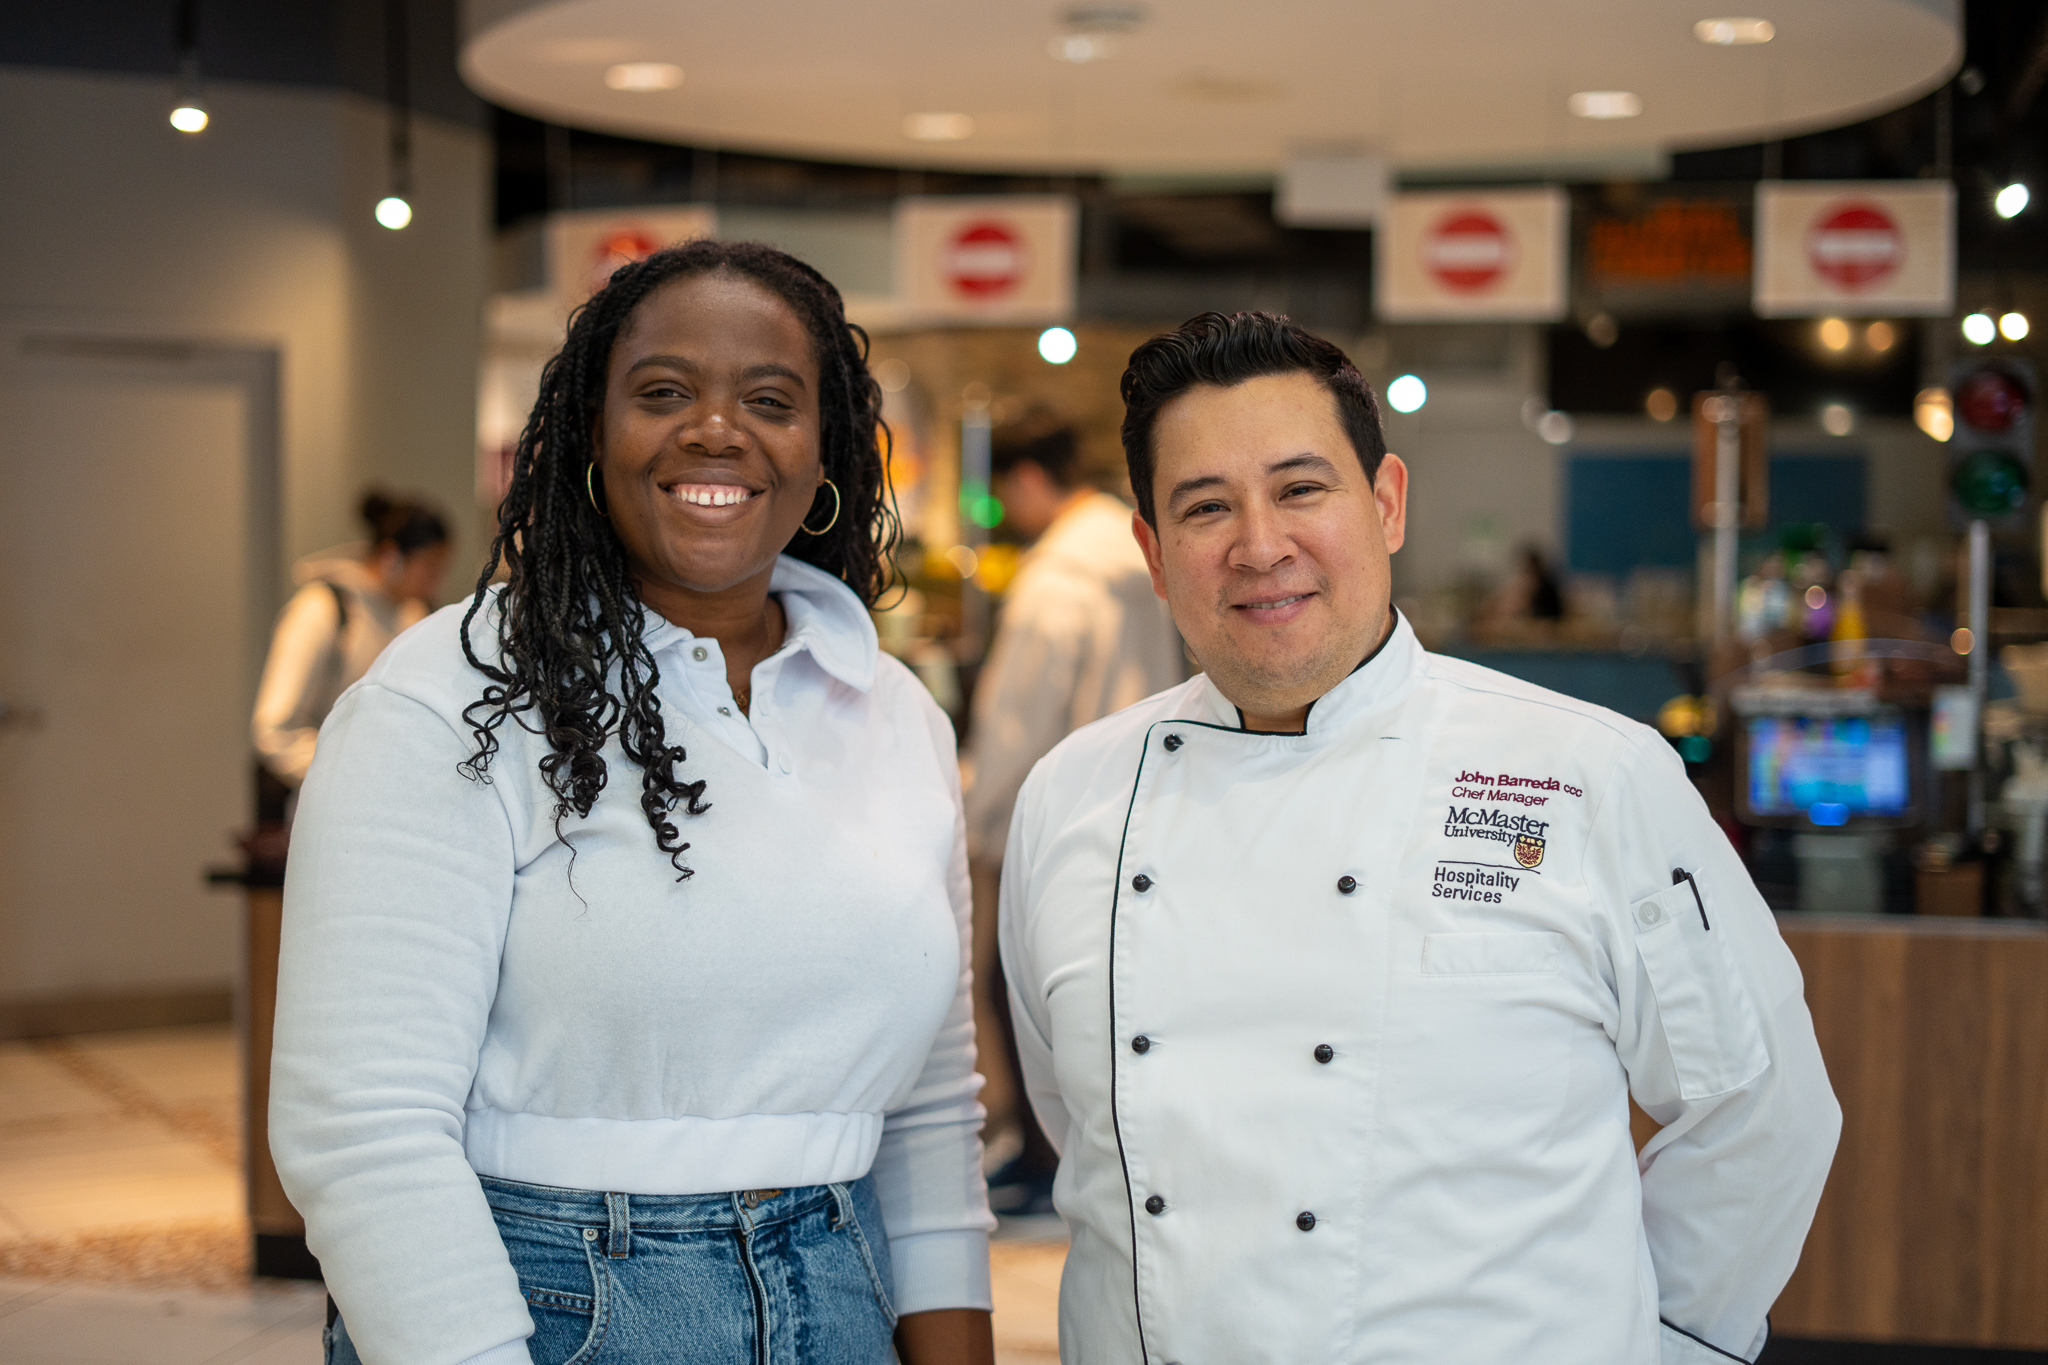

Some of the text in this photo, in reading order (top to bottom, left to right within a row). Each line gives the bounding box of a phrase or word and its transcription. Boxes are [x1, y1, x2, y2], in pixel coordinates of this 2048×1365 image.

[1455, 770, 1495, 786] John
[1497, 774, 1560, 791] Barreda
[1452, 786, 1549, 806] Chef Manager
[1445, 806, 1549, 837] McMaster
[1444, 825, 1516, 847] University
[1434, 867, 1520, 892] Hospitality
[1432, 883, 1502, 903] Services
